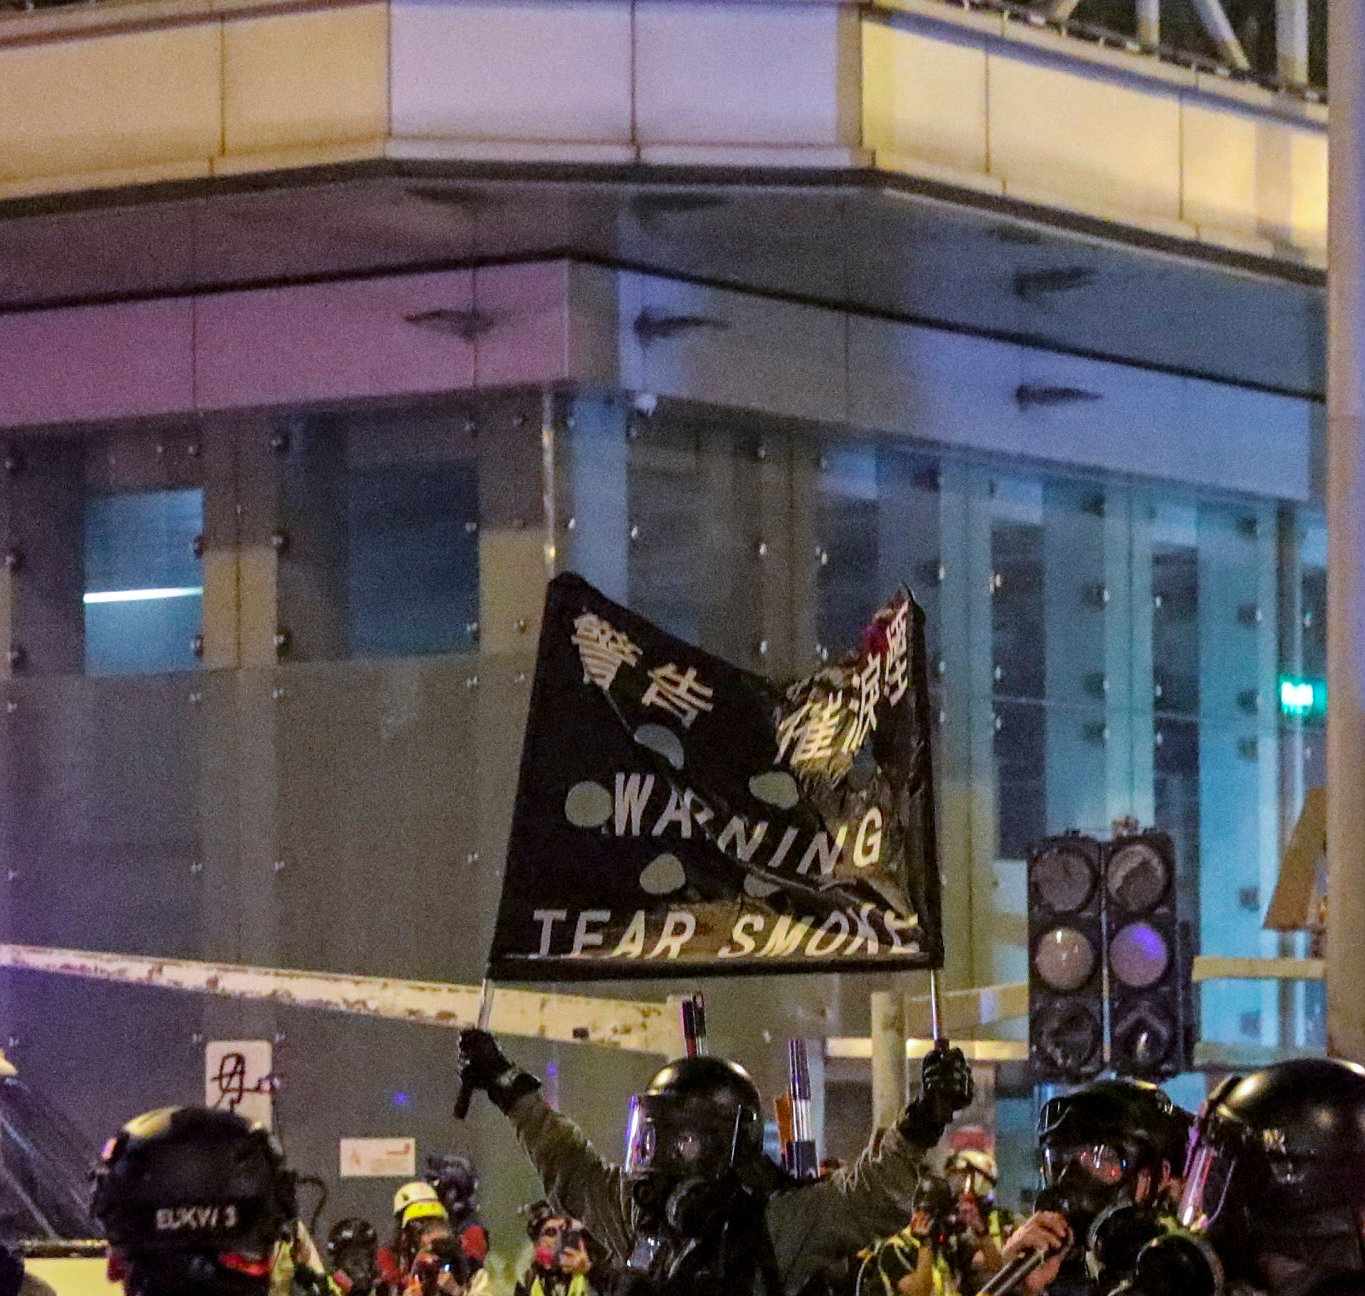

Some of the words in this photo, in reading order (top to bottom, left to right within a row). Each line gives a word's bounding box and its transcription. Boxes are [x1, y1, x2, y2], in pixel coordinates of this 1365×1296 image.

[571, 612, 714, 729] 警告
[615, 772, 883, 876] WANING
[533, 909, 696, 959] TEAR
[718, 906, 920, 958] SMOKE
